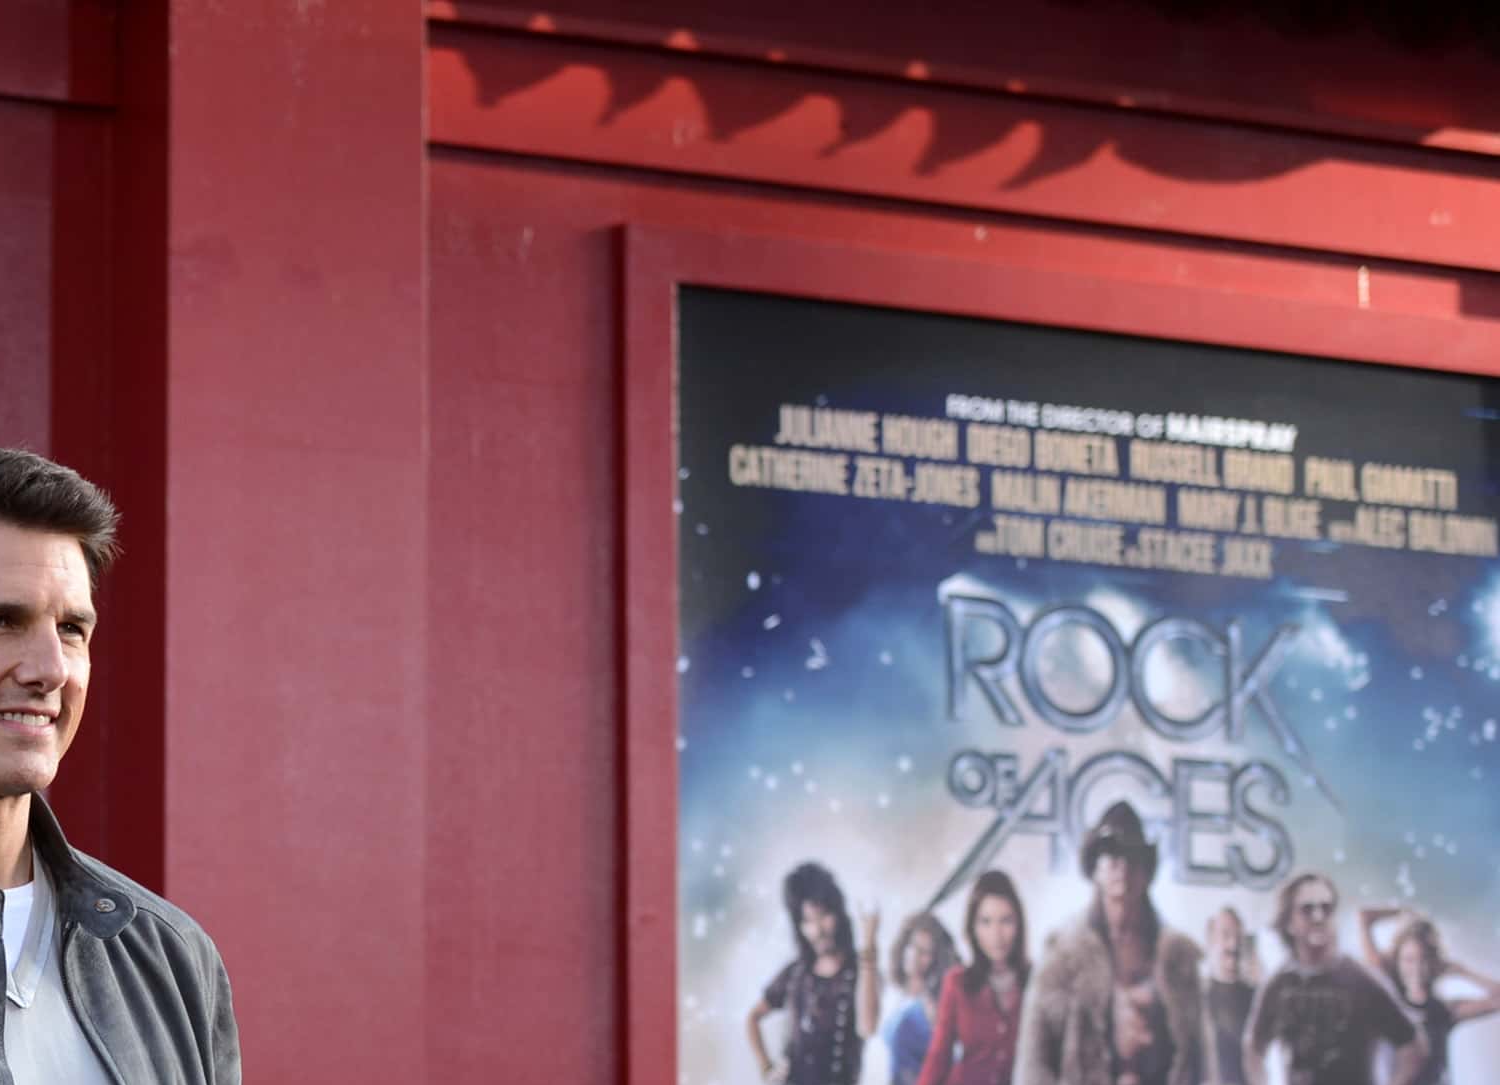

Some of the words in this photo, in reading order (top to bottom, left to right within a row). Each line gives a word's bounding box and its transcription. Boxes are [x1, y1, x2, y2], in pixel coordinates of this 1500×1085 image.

[947, 593, 1346, 818] ROCK
[947, 748, 1020, 808] OF
[925, 747, 1293, 912] AGES
